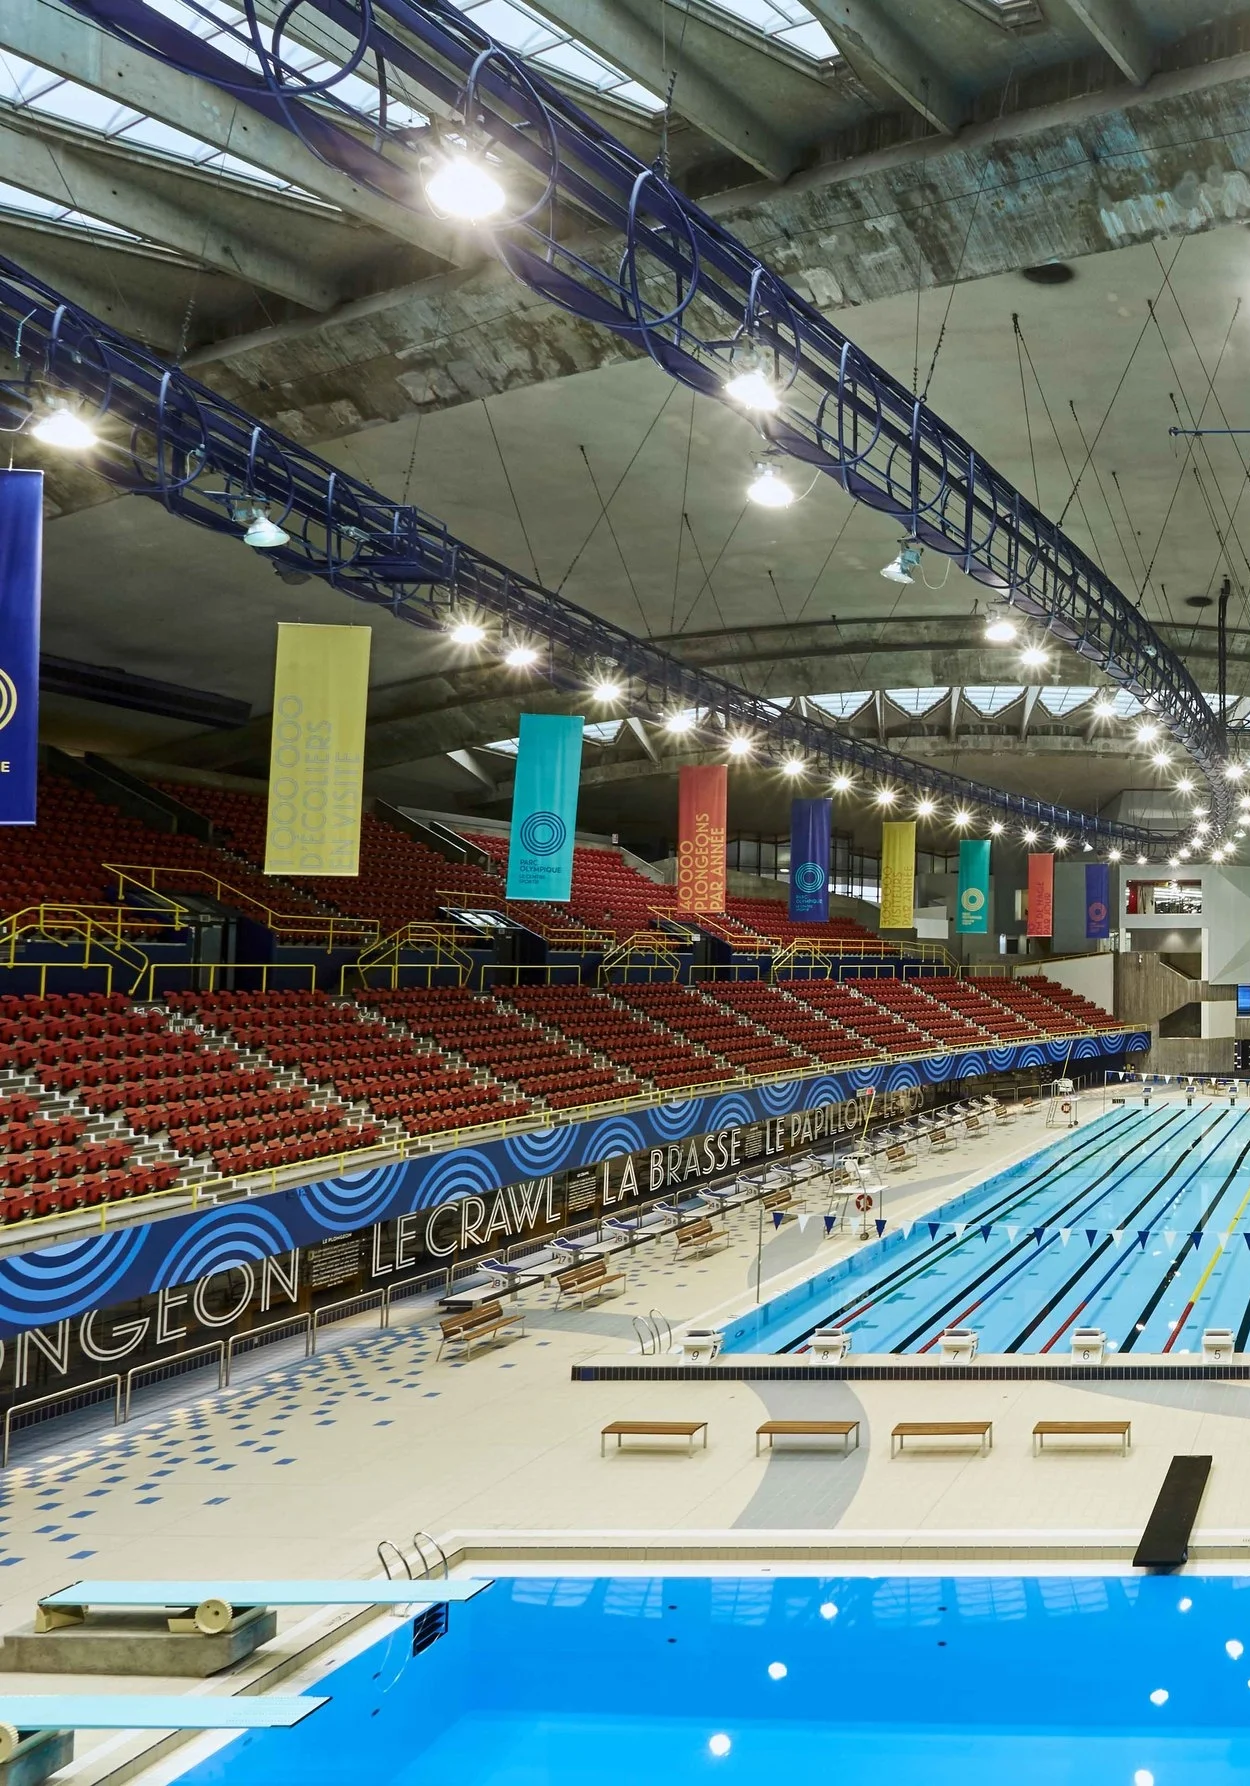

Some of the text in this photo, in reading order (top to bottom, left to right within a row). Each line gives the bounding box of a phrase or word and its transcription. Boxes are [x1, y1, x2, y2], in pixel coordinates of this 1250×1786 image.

[330, 752, 360, 870] EN VISITE
[520, 865, 562, 874] OLYMPIQUE
[679, 840, 694, 911] 40 000
[694, 813, 710, 911] PLONGEONS
[708, 827, 725, 910] PAR ANNÉE
[892, 871, 903, 926] VISITEURS
[766, 1117, 785, 1156] LE
[790, 1097, 868, 1148] PAPILLON
[603, 1155, 639, 1206] LA
[649, 1128, 741, 1192] BRASSE
[372, 1212, 417, 1278] LE
[426, 1176, 561, 1258] CRAWL
[0, 1247, 299, 1389] NGEON
[691, 1350, 699, 1360] 9
[821, 1351, 829, 1360] 8
[952, 1351, 958, 1360] 7
[1082, 1350, 1090, 1360] 6
[1214, 1350, 1221, 1360] 5
